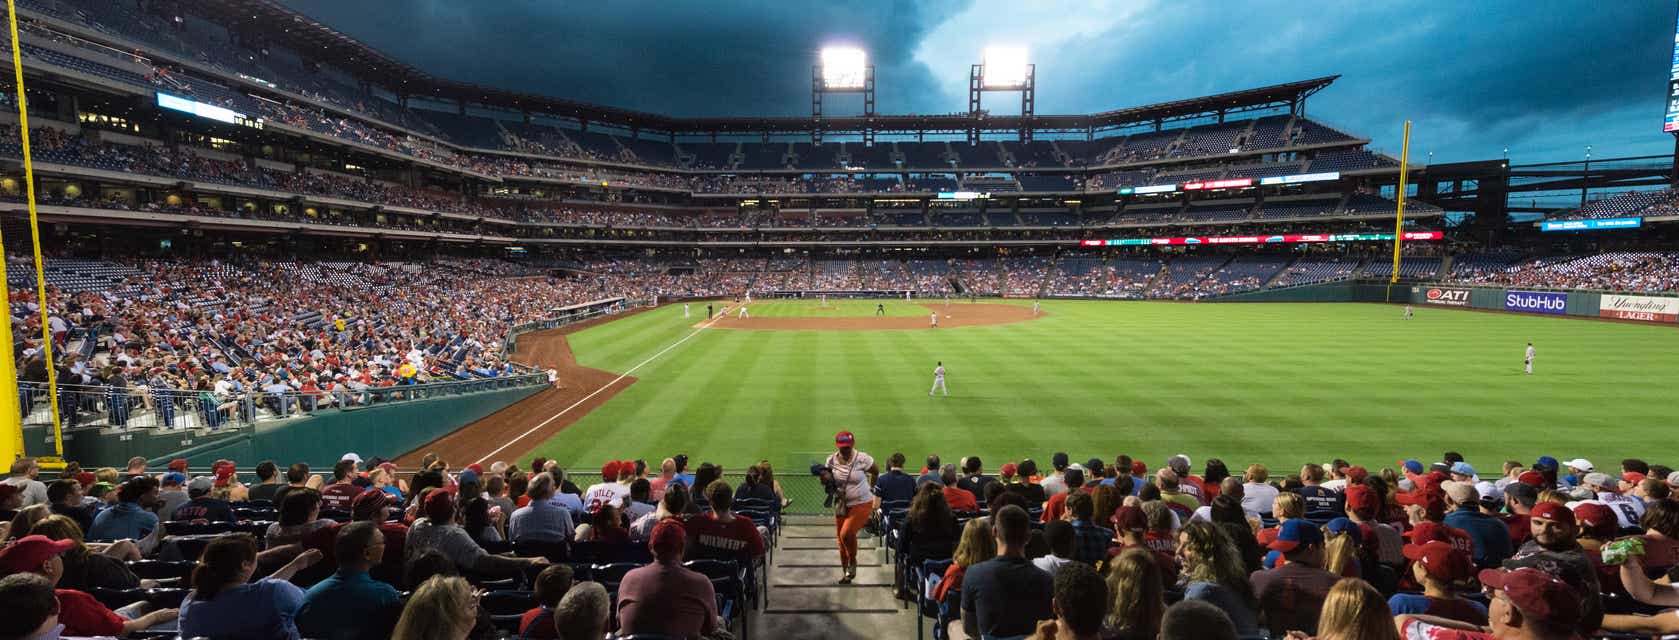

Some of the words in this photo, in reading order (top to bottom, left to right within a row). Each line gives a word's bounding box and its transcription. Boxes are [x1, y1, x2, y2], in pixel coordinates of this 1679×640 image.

[1440, 290, 1469, 301] ATI
[1506, 294, 1565, 311] StubHub
[1608, 296, 1667, 311] Yuengling
[1619, 311, 1655, 321] LAGER
[594, 488, 615, 499] UTLEY
